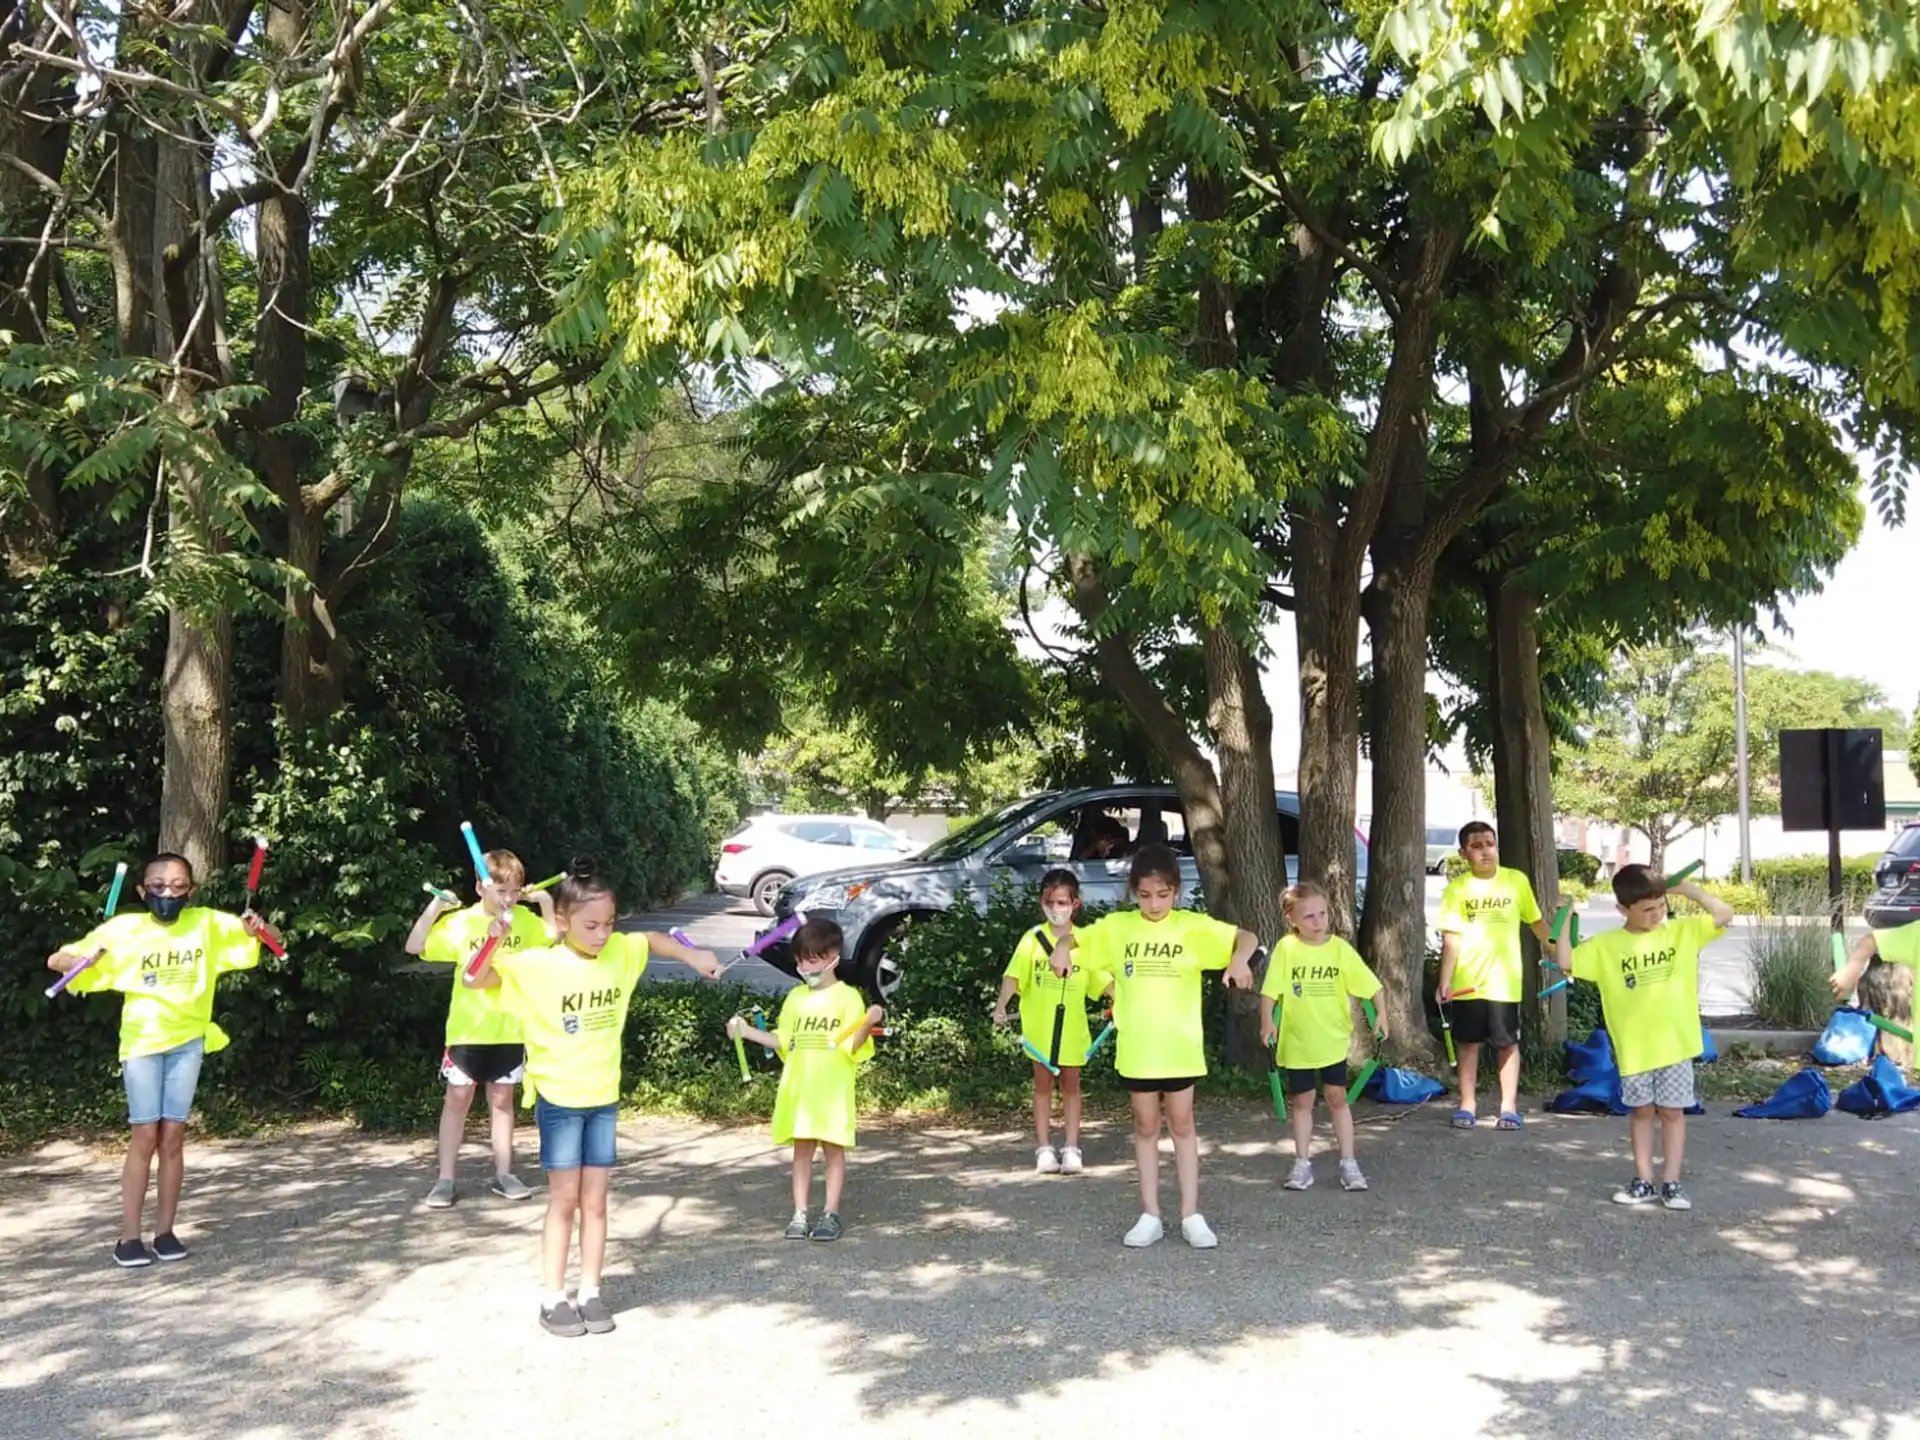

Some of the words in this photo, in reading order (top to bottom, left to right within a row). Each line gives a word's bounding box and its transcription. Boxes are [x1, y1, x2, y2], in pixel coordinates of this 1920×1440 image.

[1465, 898, 1479, 911] KI
[1482, 897, 1512, 909] HAP
[502, 935, 521, 949] AP
[1124, 942, 1139, 958] KI
[1144, 942, 1183, 958] HAP
[141, 952, 161, 970] KI
[167, 948, 203, 966] HAP
[1034, 959, 1046, 972] KI
[1621, 956, 1637, 973] KI
[1643, 947, 1676, 967] HAP
[1292, 966, 1306, 980] KI
[561, 992, 583, 1013] KI
[589, 987, 621, 1008] HAP
[804, 1016, 841, 1032] HAP
